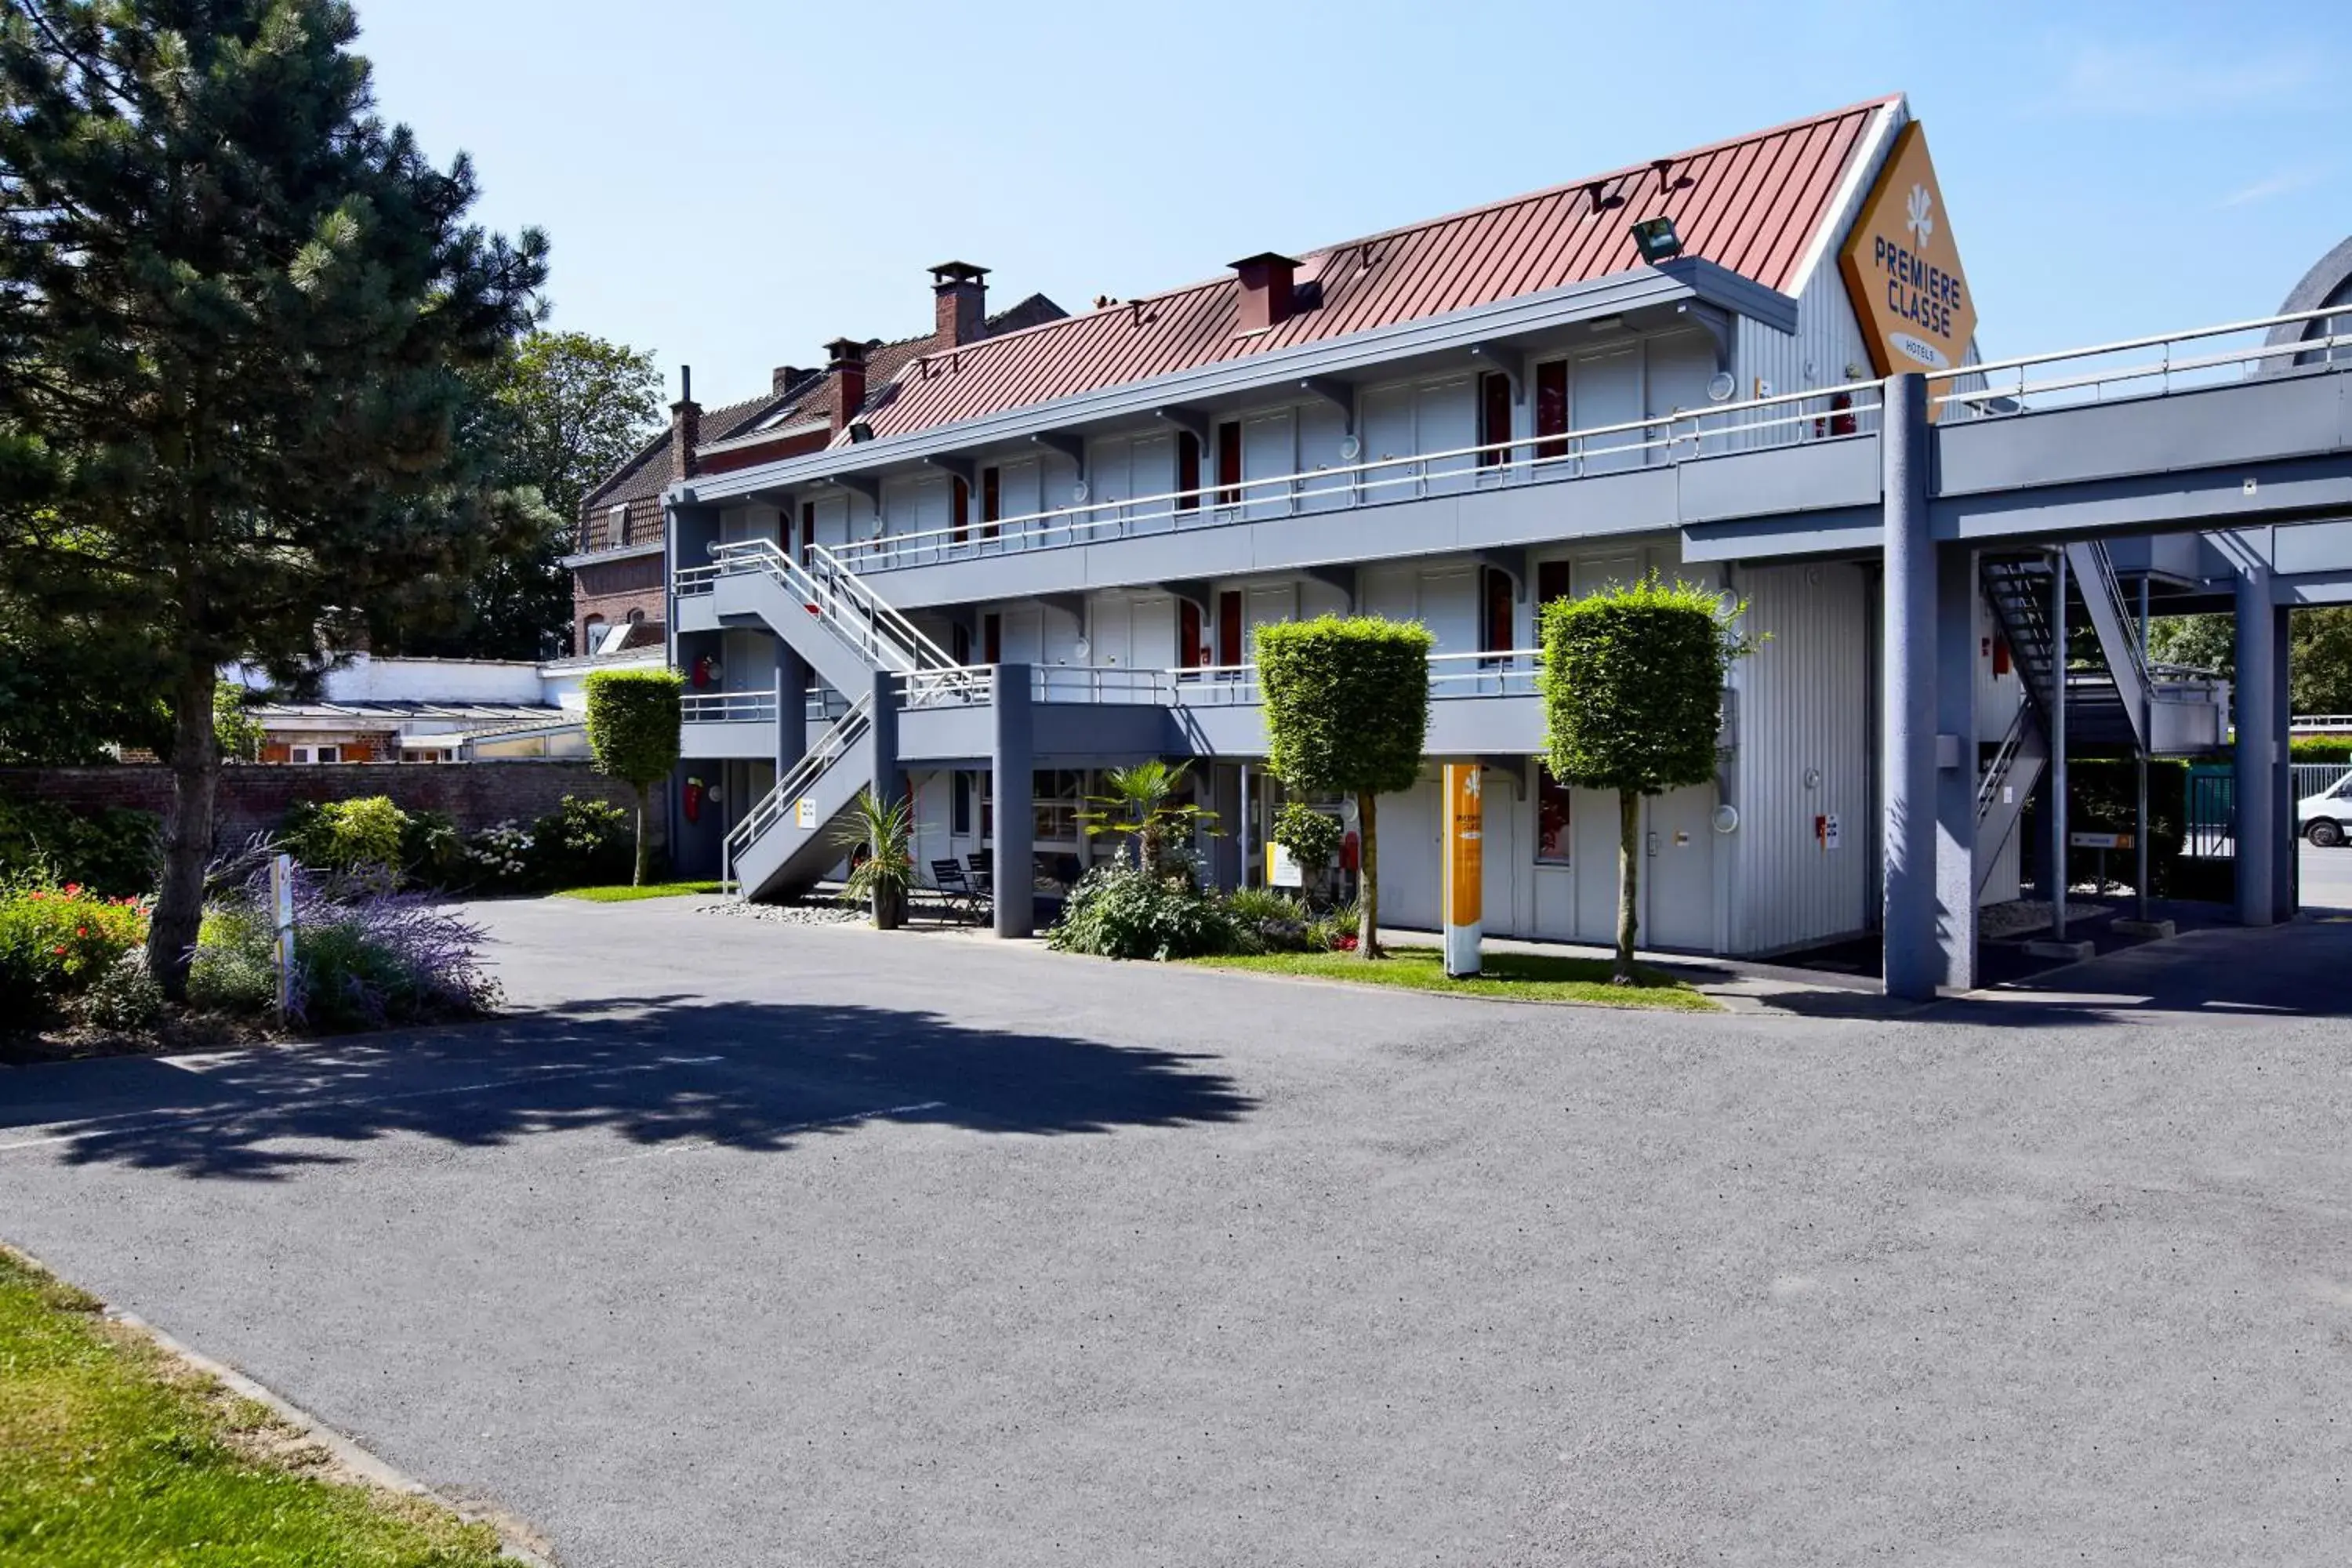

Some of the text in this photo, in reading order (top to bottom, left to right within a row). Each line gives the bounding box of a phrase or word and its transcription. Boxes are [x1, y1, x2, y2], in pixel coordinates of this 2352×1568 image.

[1875, 236, 1960, 310] PREMIERE
[1888, 278, 1951, 339] CLASSE
[1906, 339, 1934, 362] HOTELS
